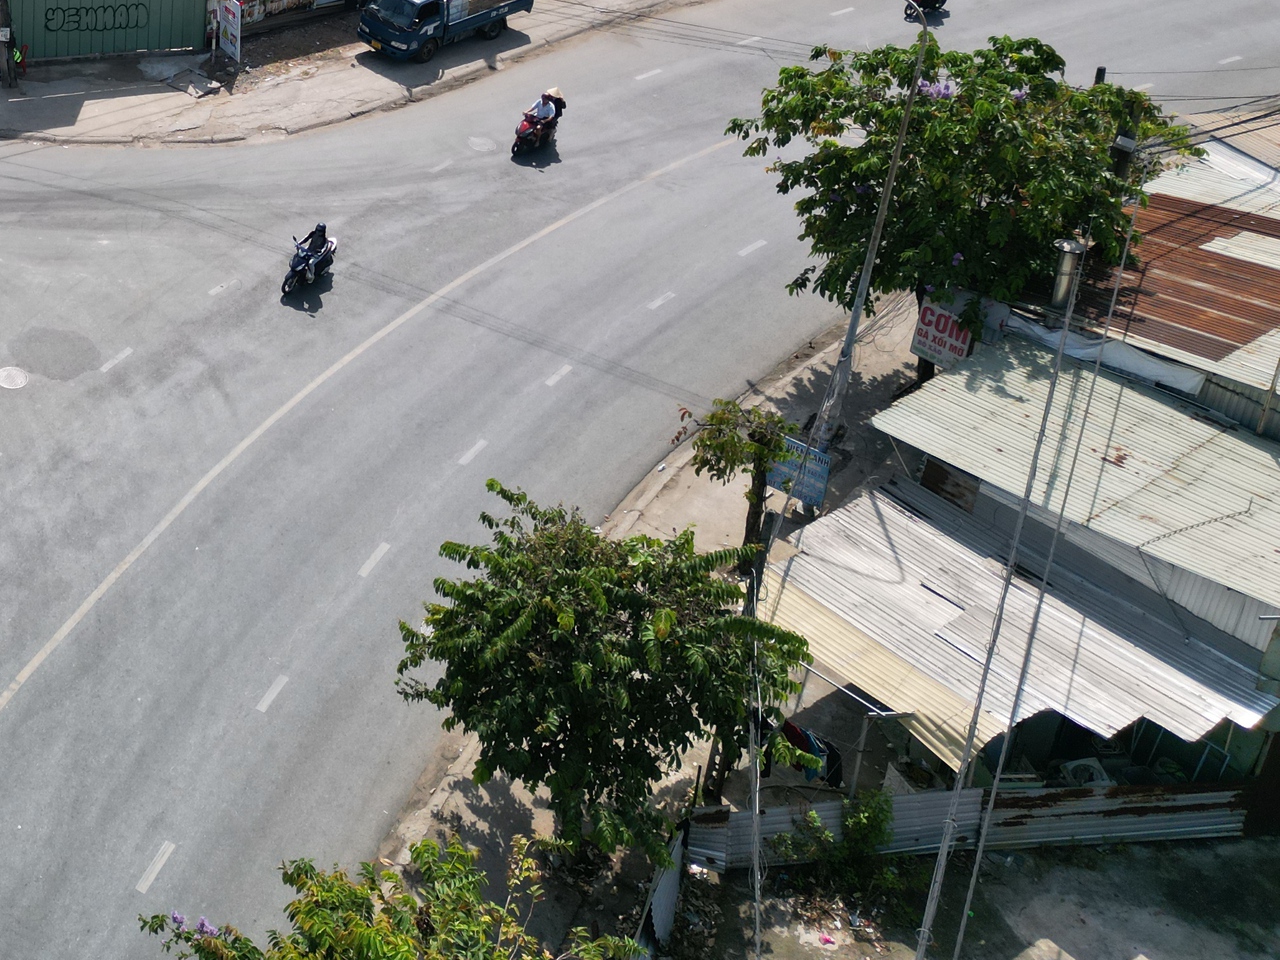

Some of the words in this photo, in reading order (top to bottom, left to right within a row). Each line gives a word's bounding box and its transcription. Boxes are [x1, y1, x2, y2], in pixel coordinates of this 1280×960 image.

[916, 327, 929, 340] GÀ
[931, 334, 947, 350] XỐI
[920, 305, 970, 346] CƠM
